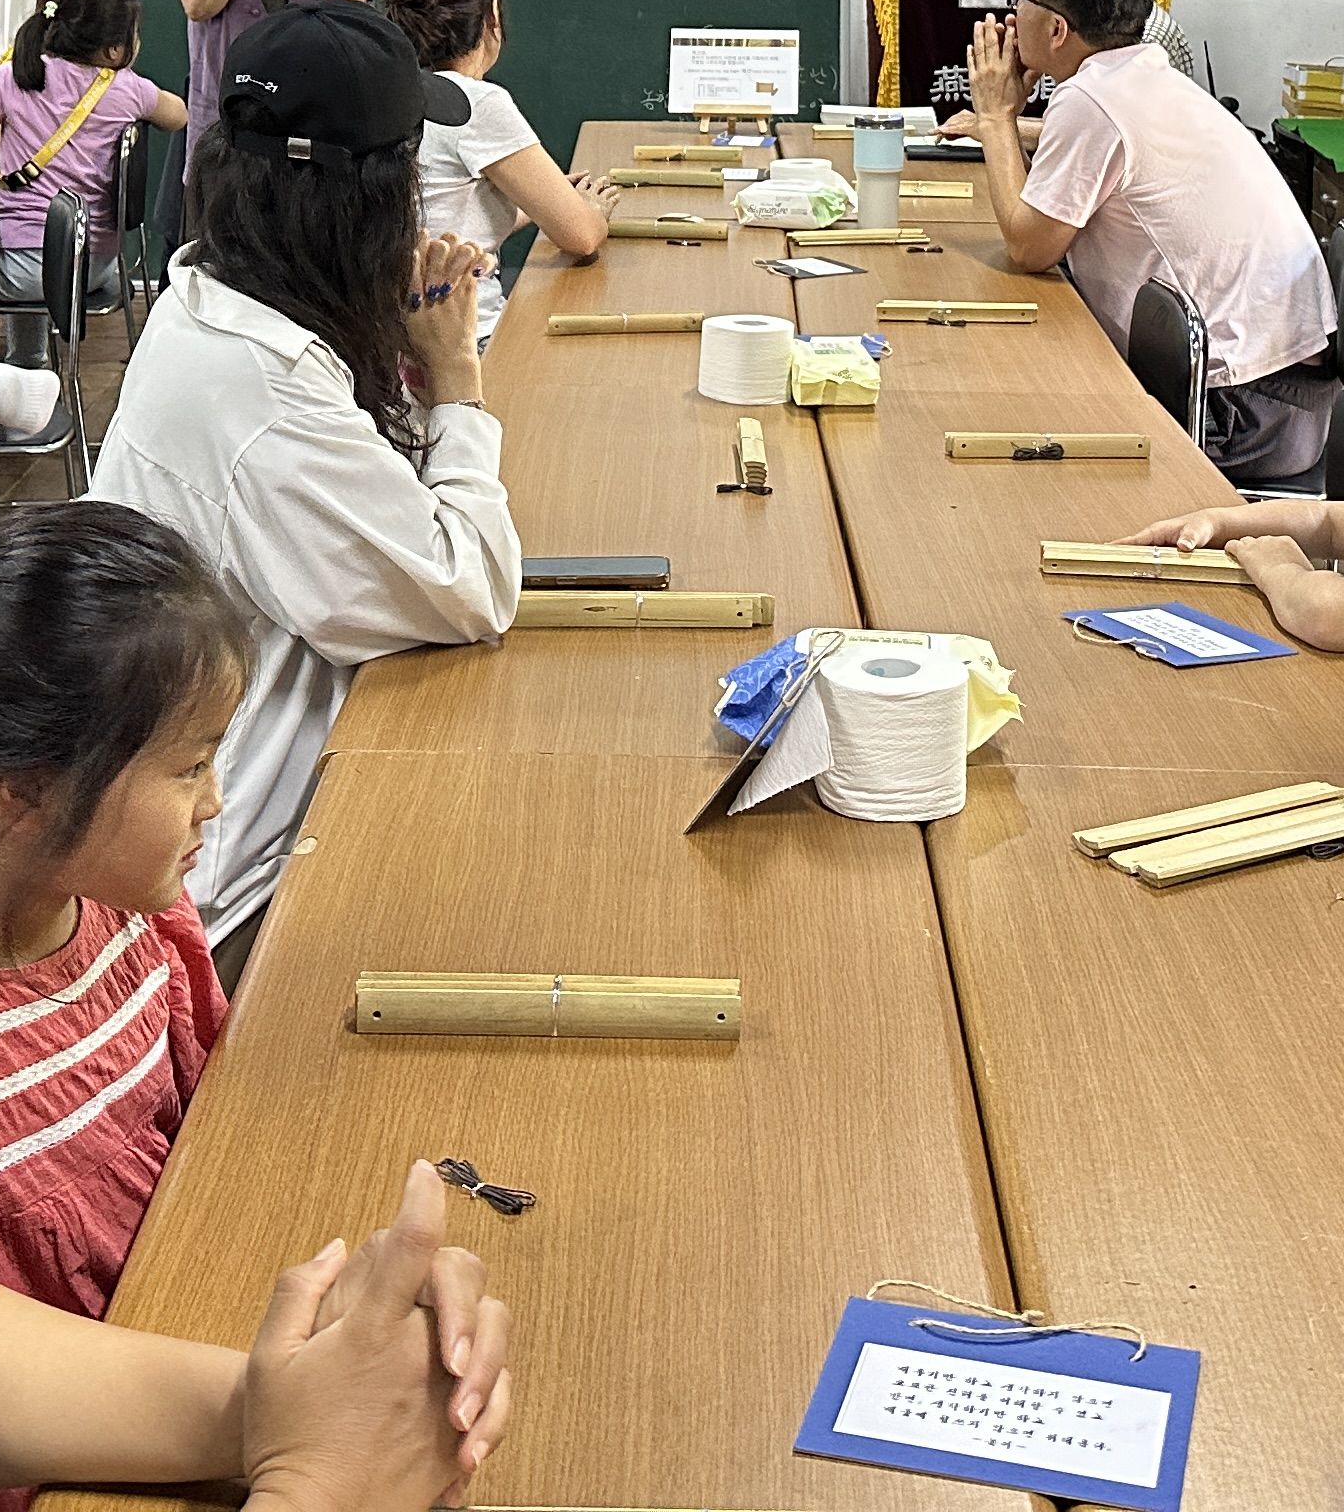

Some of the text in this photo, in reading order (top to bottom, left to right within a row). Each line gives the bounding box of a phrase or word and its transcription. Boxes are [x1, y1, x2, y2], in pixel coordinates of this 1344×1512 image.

[964, 1375, 993, 1388] 하고
[1000, 1383, 1061, 1400] 생각하지
[1051, 1406, 1065, 1415] 수
[1016, 1413, 1046, 1425] 하고
